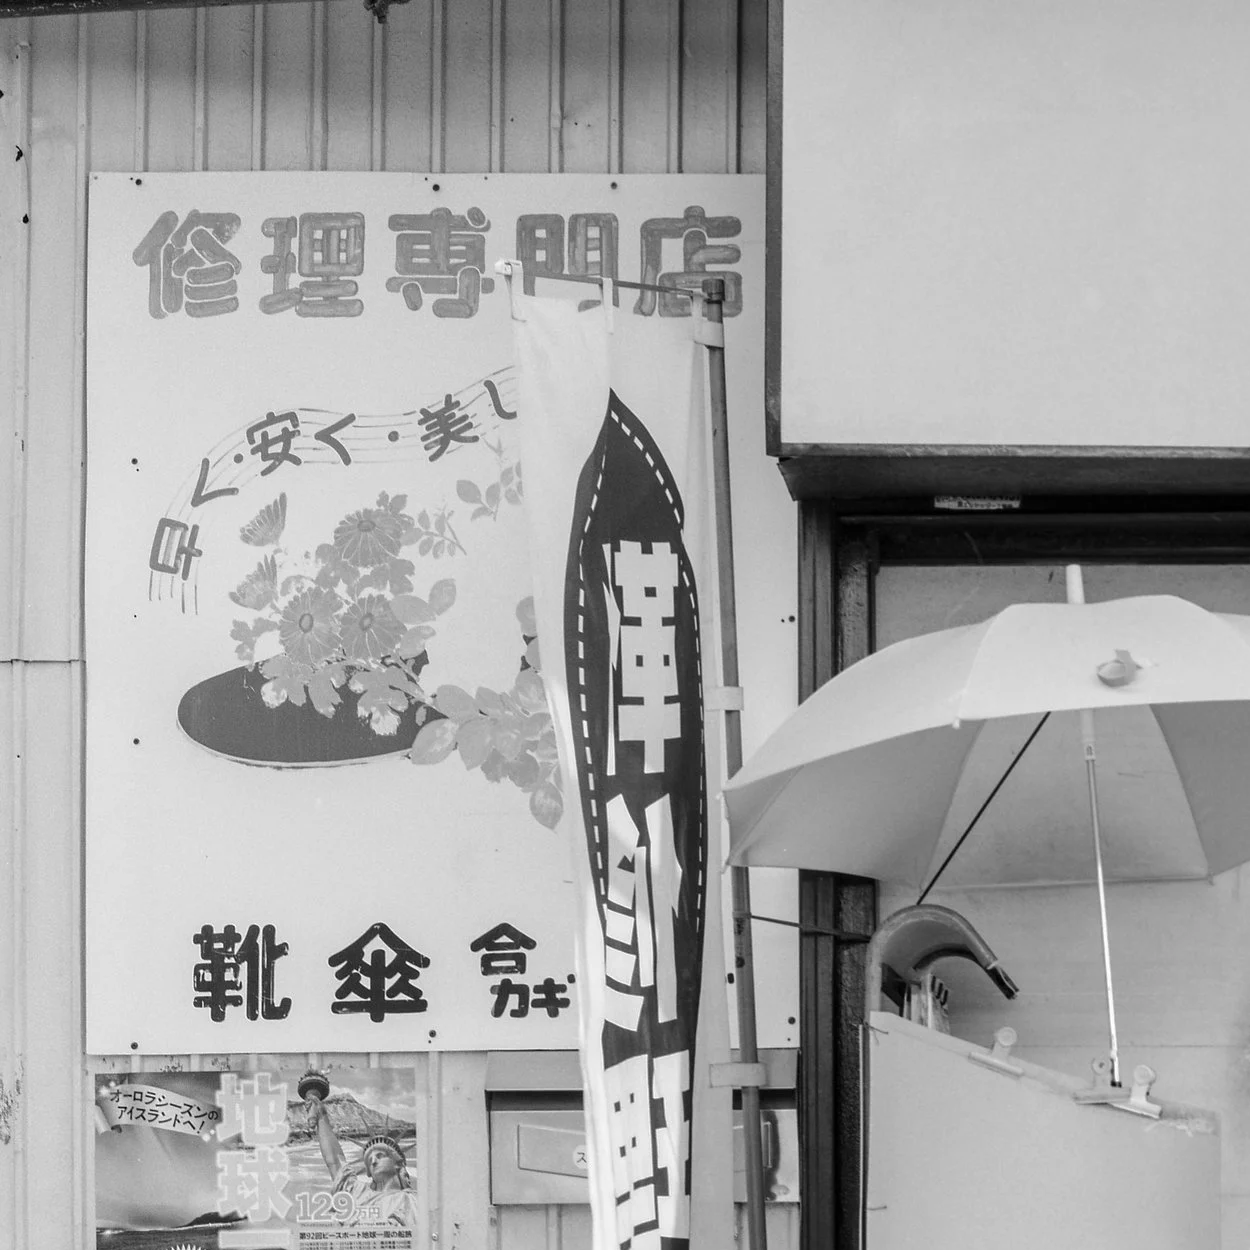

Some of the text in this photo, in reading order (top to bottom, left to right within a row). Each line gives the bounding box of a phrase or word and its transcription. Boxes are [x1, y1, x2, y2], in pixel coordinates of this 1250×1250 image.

[193, 924, 292, 1023] 靴
[328, 922, 431, 1023] 傘
[110, 1088, 219, 1123] オーロラシーズンの
